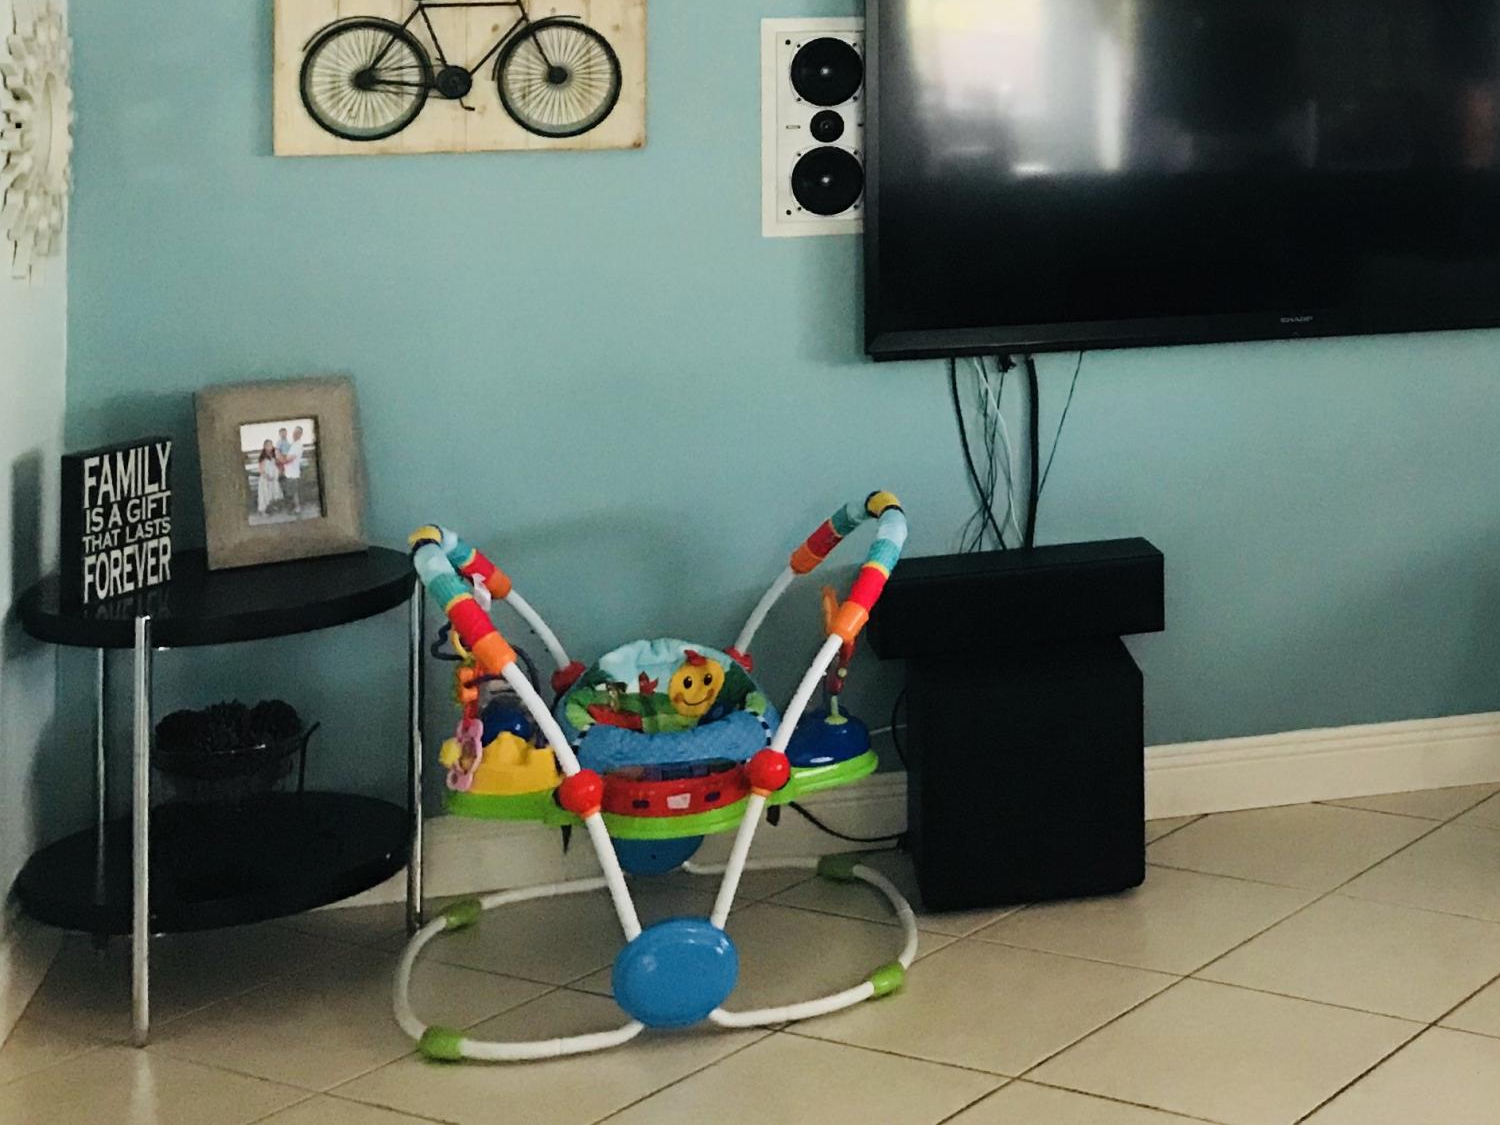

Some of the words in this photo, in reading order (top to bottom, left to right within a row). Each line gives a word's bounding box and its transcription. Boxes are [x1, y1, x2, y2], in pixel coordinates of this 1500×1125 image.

[84, 441, 172, 509] FAMILY
[82, 528, 121, 553] THAT
[125, 517, 172, 543] LASTS
[85, 507, 104, 534] IS
[108, 503, 122, 528] A
[126, 490, 171, 523] GIFT
[83, 536, 172, 604] FOREVER
